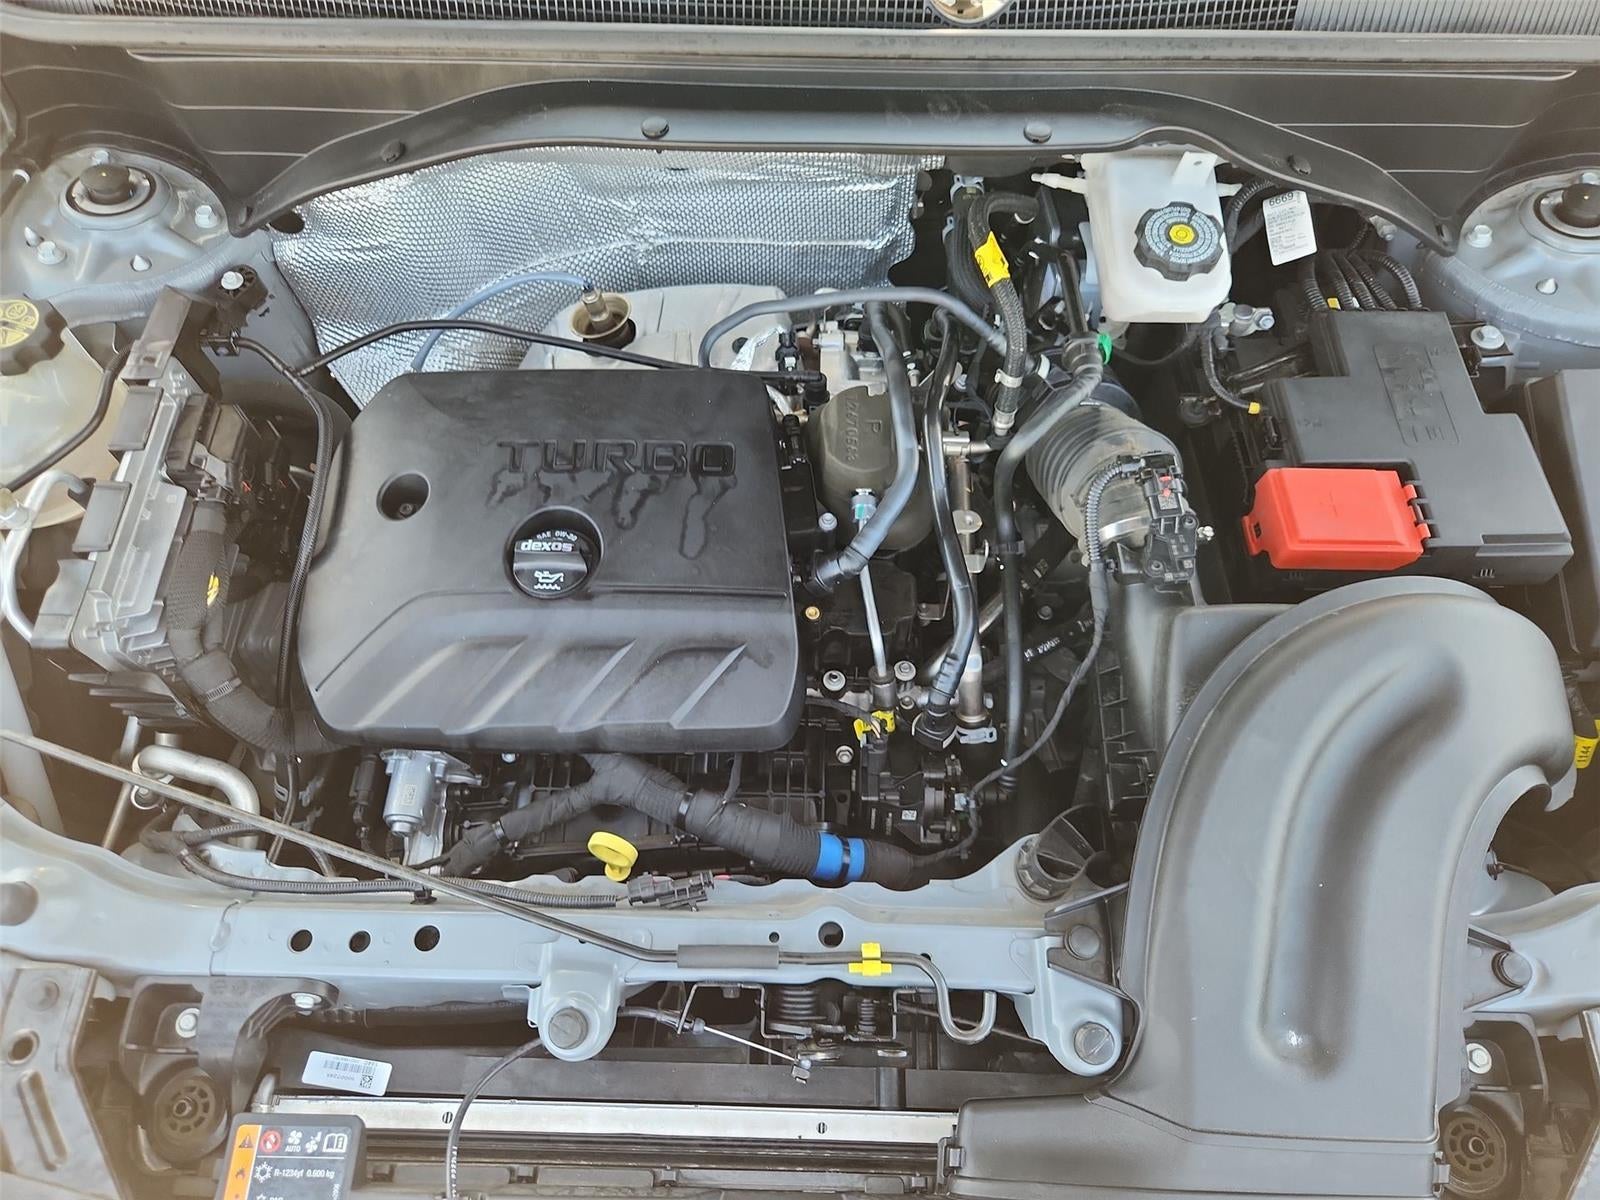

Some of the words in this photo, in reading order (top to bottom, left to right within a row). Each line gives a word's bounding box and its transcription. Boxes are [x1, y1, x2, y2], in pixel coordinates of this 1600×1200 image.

[496, 439, 736, 477] TURBO
[520, 539, 573, 552] dexos
[284, 1145, 301, 1153] AUTO
